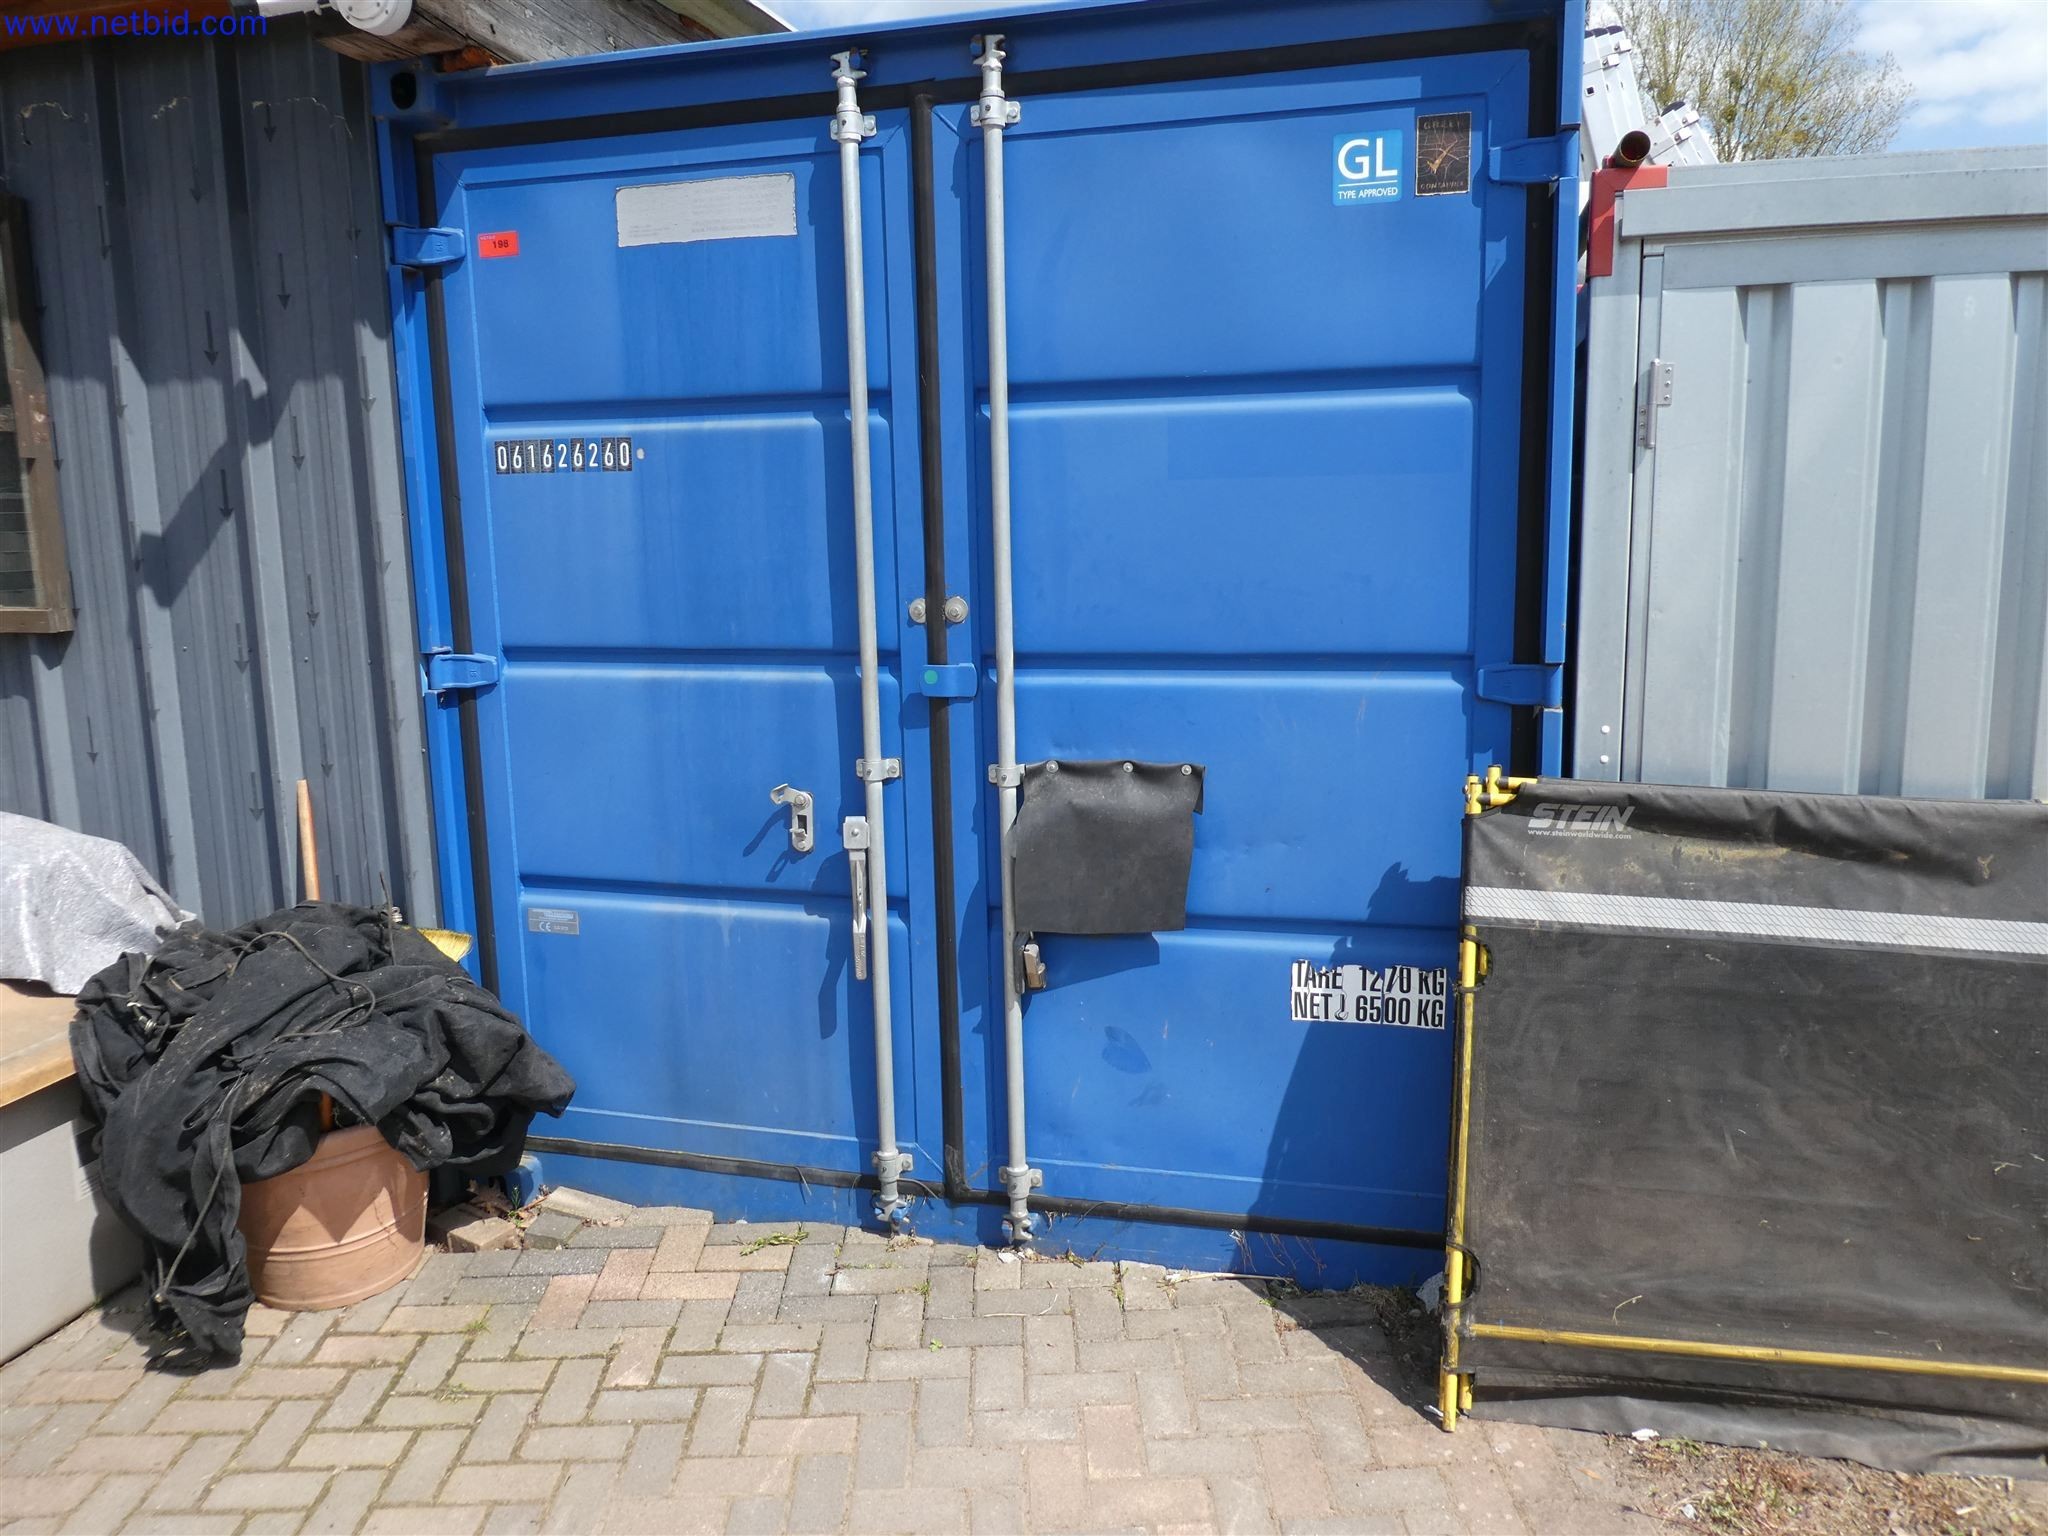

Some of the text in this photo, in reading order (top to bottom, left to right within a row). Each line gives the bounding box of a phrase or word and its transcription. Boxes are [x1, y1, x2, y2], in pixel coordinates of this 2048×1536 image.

[1338, 137, 1398, 180] GL
[1338, 186, 1398, 200] TYPE APPROVED
[492, 239, 510, 249] 198
[497, 442, 630, 470] 061626260
[1528, 802, 1636, 832] STEIN
[1527, 829, 1632, 840] www.steinworldwide.com
[1418, 967, 1445, 997] KG
[1294, 991, 1444, 1028] NET 6500 KG
